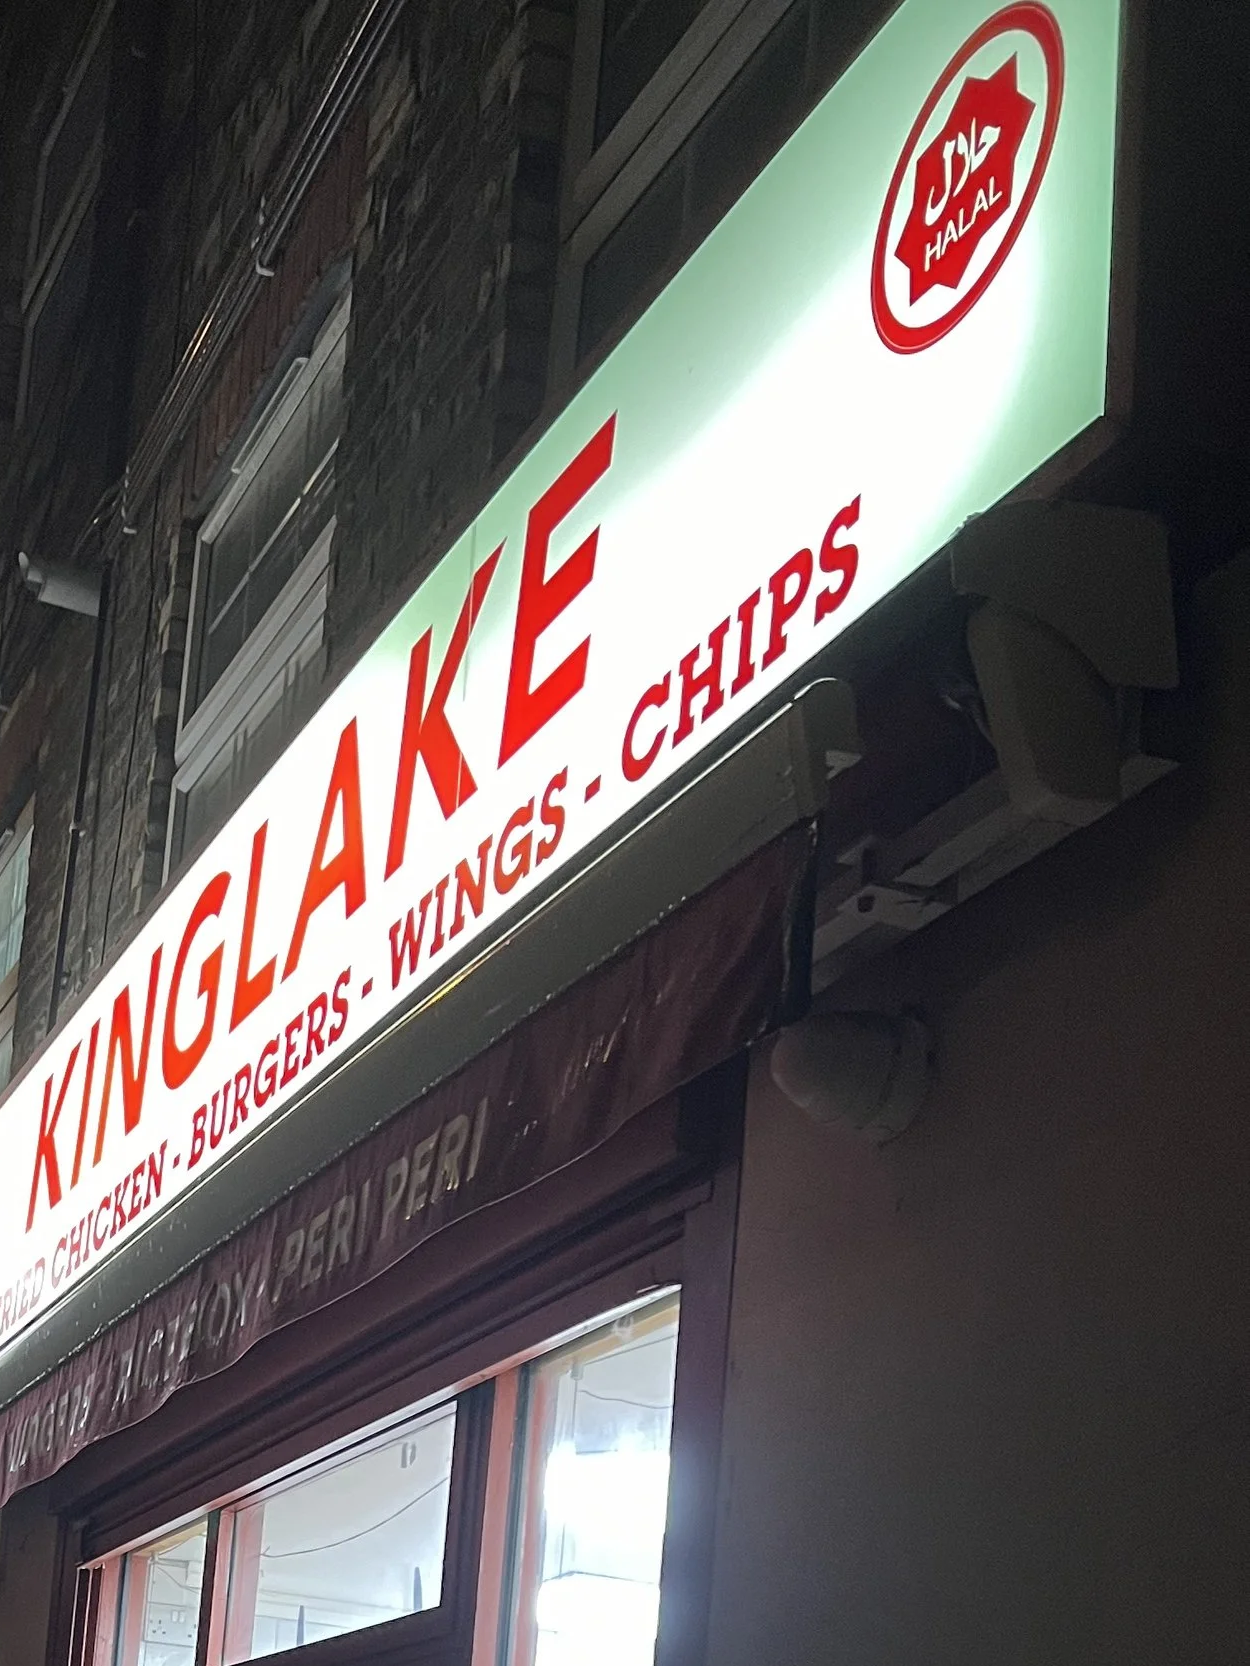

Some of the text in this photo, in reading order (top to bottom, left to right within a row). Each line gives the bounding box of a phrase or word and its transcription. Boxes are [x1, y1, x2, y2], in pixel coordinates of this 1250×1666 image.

[923, 176, 1002, 273] HALAL
[25, 409, 618, 1234] KINGLAKE
[51, 1139, 168, 1289] CHICKEN
[187, 966, 351, 1171] BURGERS
[388, 765, 568, 990] WINGS
[621, 493, 862, 782] CHIPS
[271, 1176, 371, 1304] PERI
[379, 1097, 488, 1242] PERI
